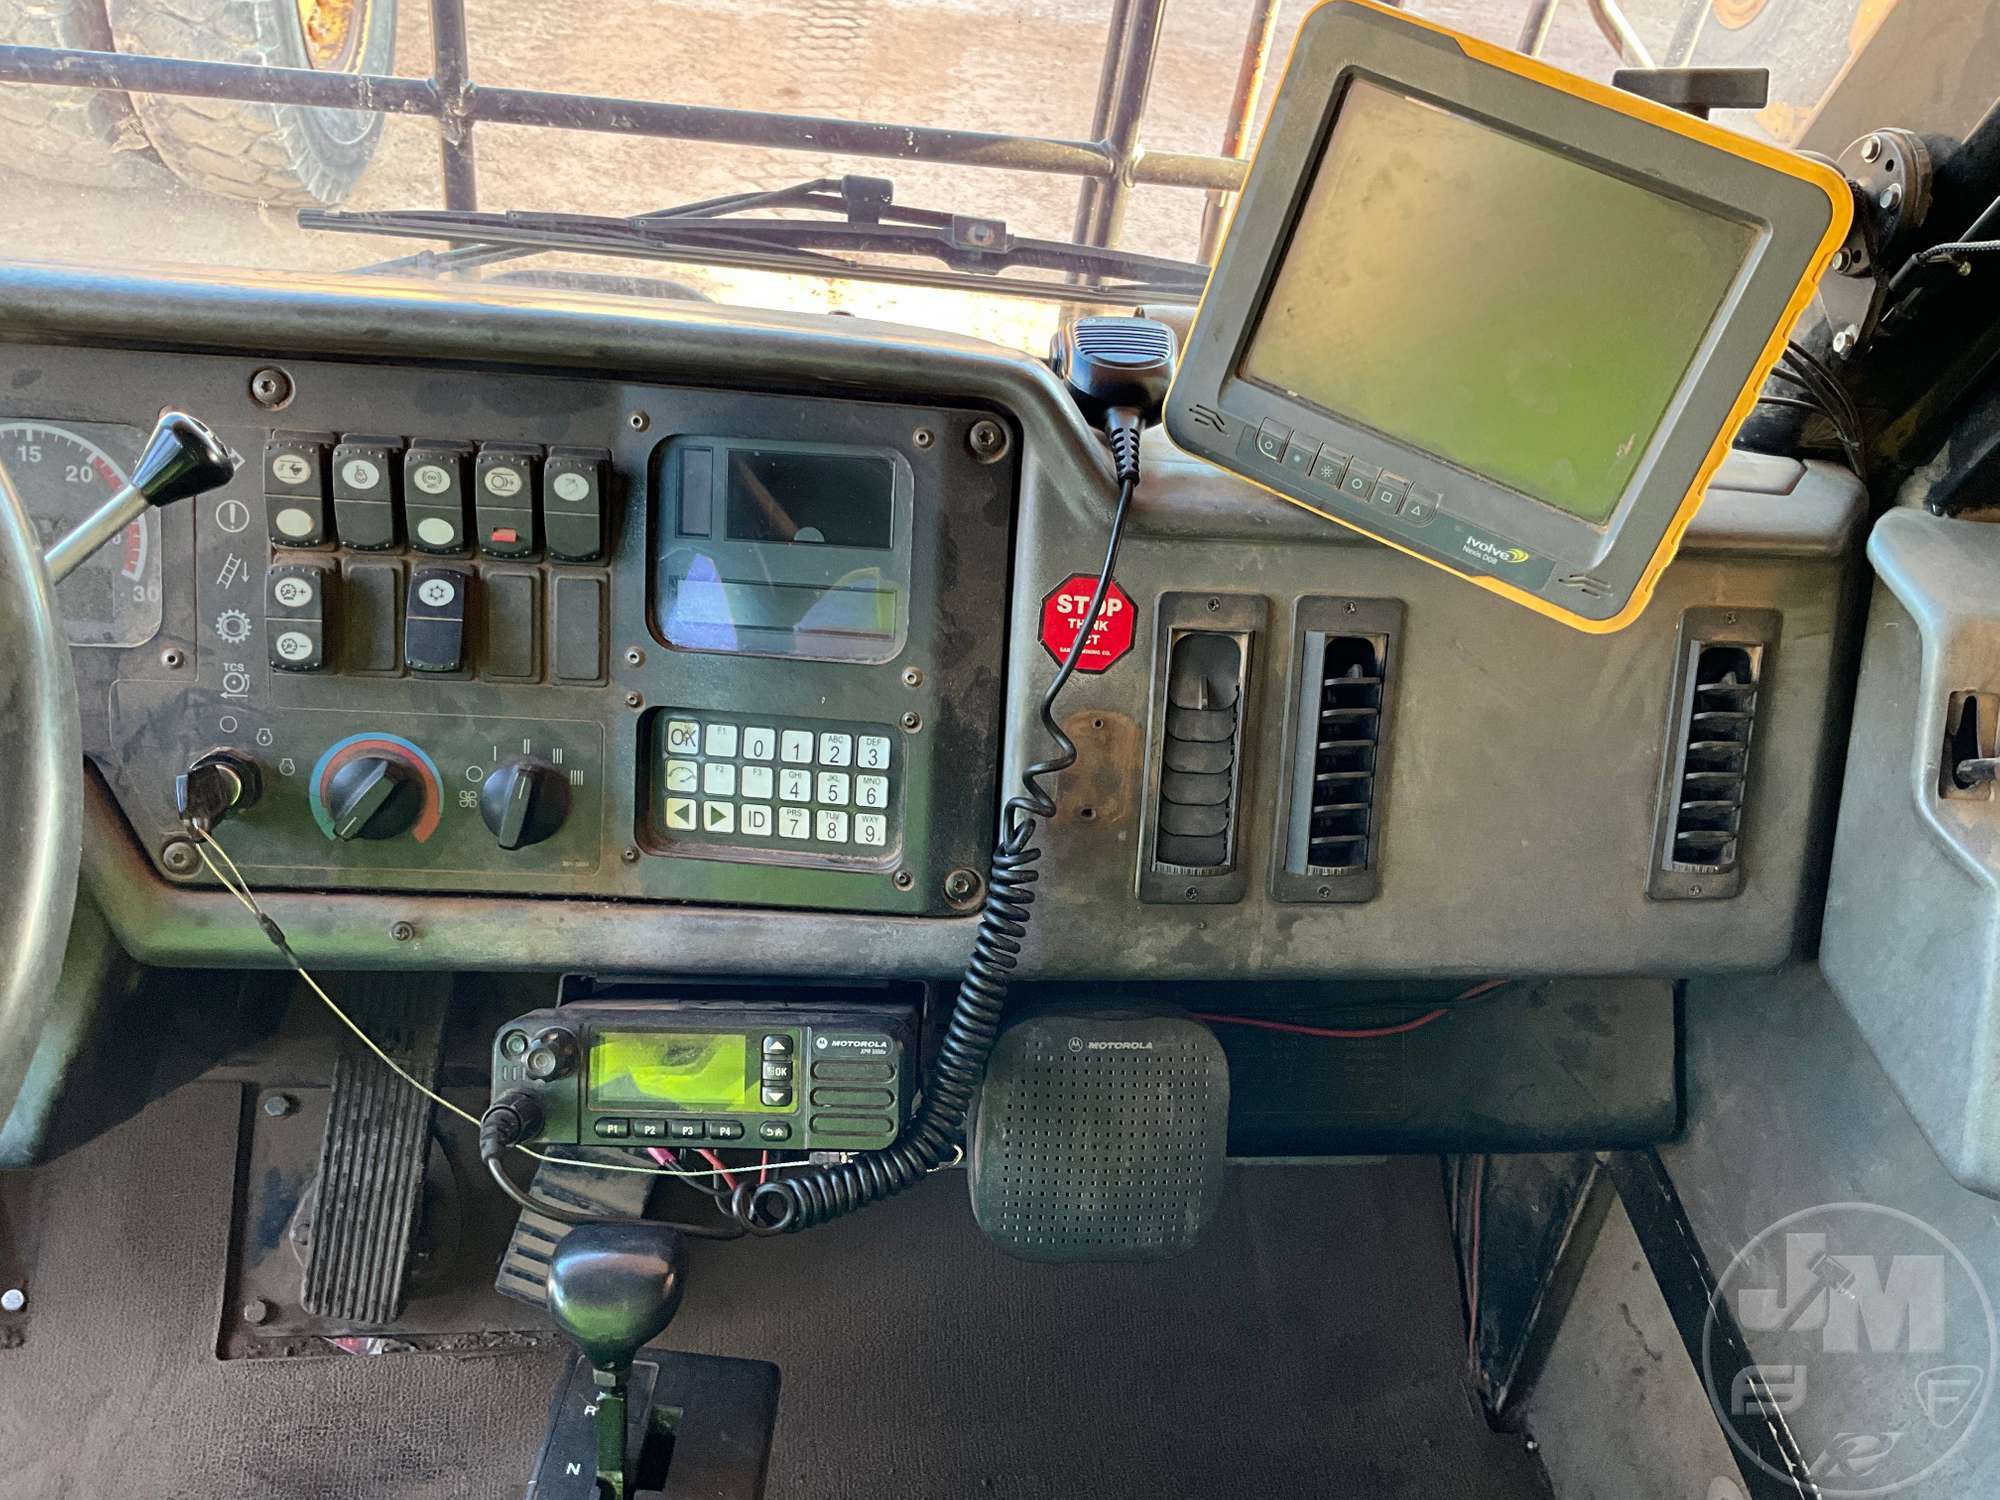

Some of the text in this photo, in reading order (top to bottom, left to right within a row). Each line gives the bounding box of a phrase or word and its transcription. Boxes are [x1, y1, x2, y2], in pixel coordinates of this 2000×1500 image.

[17, 446, 42, 463] 15
[65, 465, 94, 483] 20
[133, 585, 160, 602] 30
[1067, 618, 1109, 631] THNK
[223, 662, 245, 672] TCS
[671, 728, 697, 747] OK
[828, 735, 844, 744] ABC
[866, 737, 881, 746] DEF
[753, 739, 764, 758] 0
[792, 743, 800, 761] 1
[830, 745, 840, 763] 2
[868, 748, 878, 767] 3
[863, 777, 881, 786] MNO
[789, 782, 799, 799] 4
[828, 784, 838, 802] 5
[866, 787, 876, 805] 6
[786, 809, 802, 817] PRS
[862, 815, 879, 823] WXY
[790, 818, 799, 835] 7
[827, 822, 837, 839] 8
[865, 825, 875, 843] 9
[831, 1040, 888, 1048] MOTOROLA
[1088, 1041, 1153, 1050] MOTOROLA
[774, 1067, 788, 1077] OK
[606, 1124, 618, 1134] P1
[644, 1125, 656, 1135] P2
[682, 1126, 694, 1136] P3
[719, 1127, 731, 1137] P4
[584, 1405, 597, 1416] R
[566, 1463, 581, 1475] N
